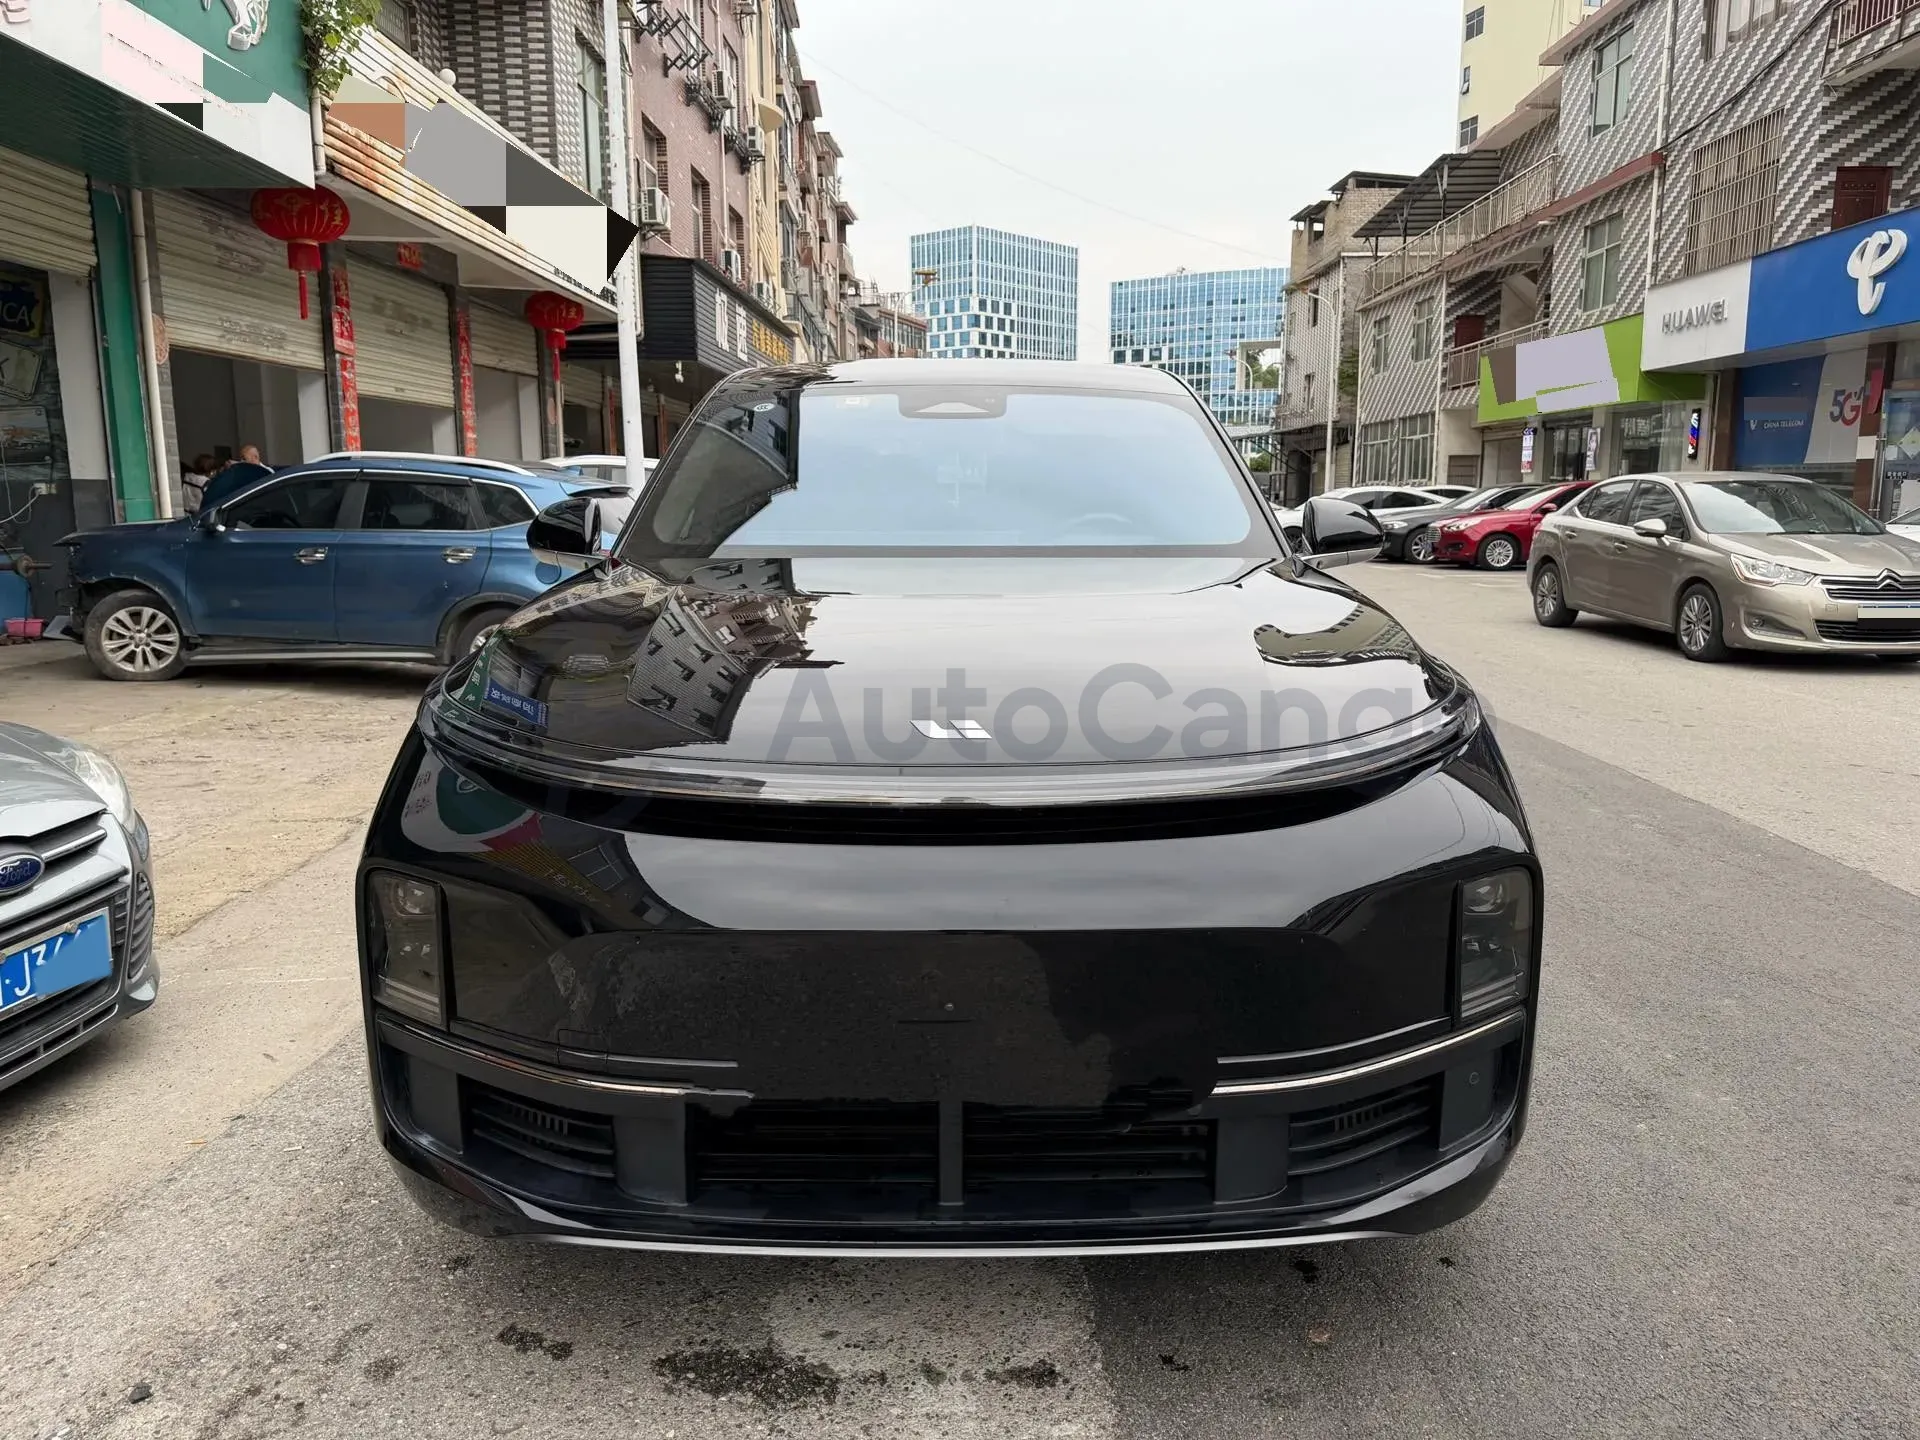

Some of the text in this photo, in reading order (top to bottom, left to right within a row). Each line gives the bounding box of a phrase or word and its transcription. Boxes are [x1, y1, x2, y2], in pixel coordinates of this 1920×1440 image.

[1662, 299, 1727, 334] HUAWEI
[1829, 388, 1863, 427] 5G
[0, 860, 33, 885] Ford
